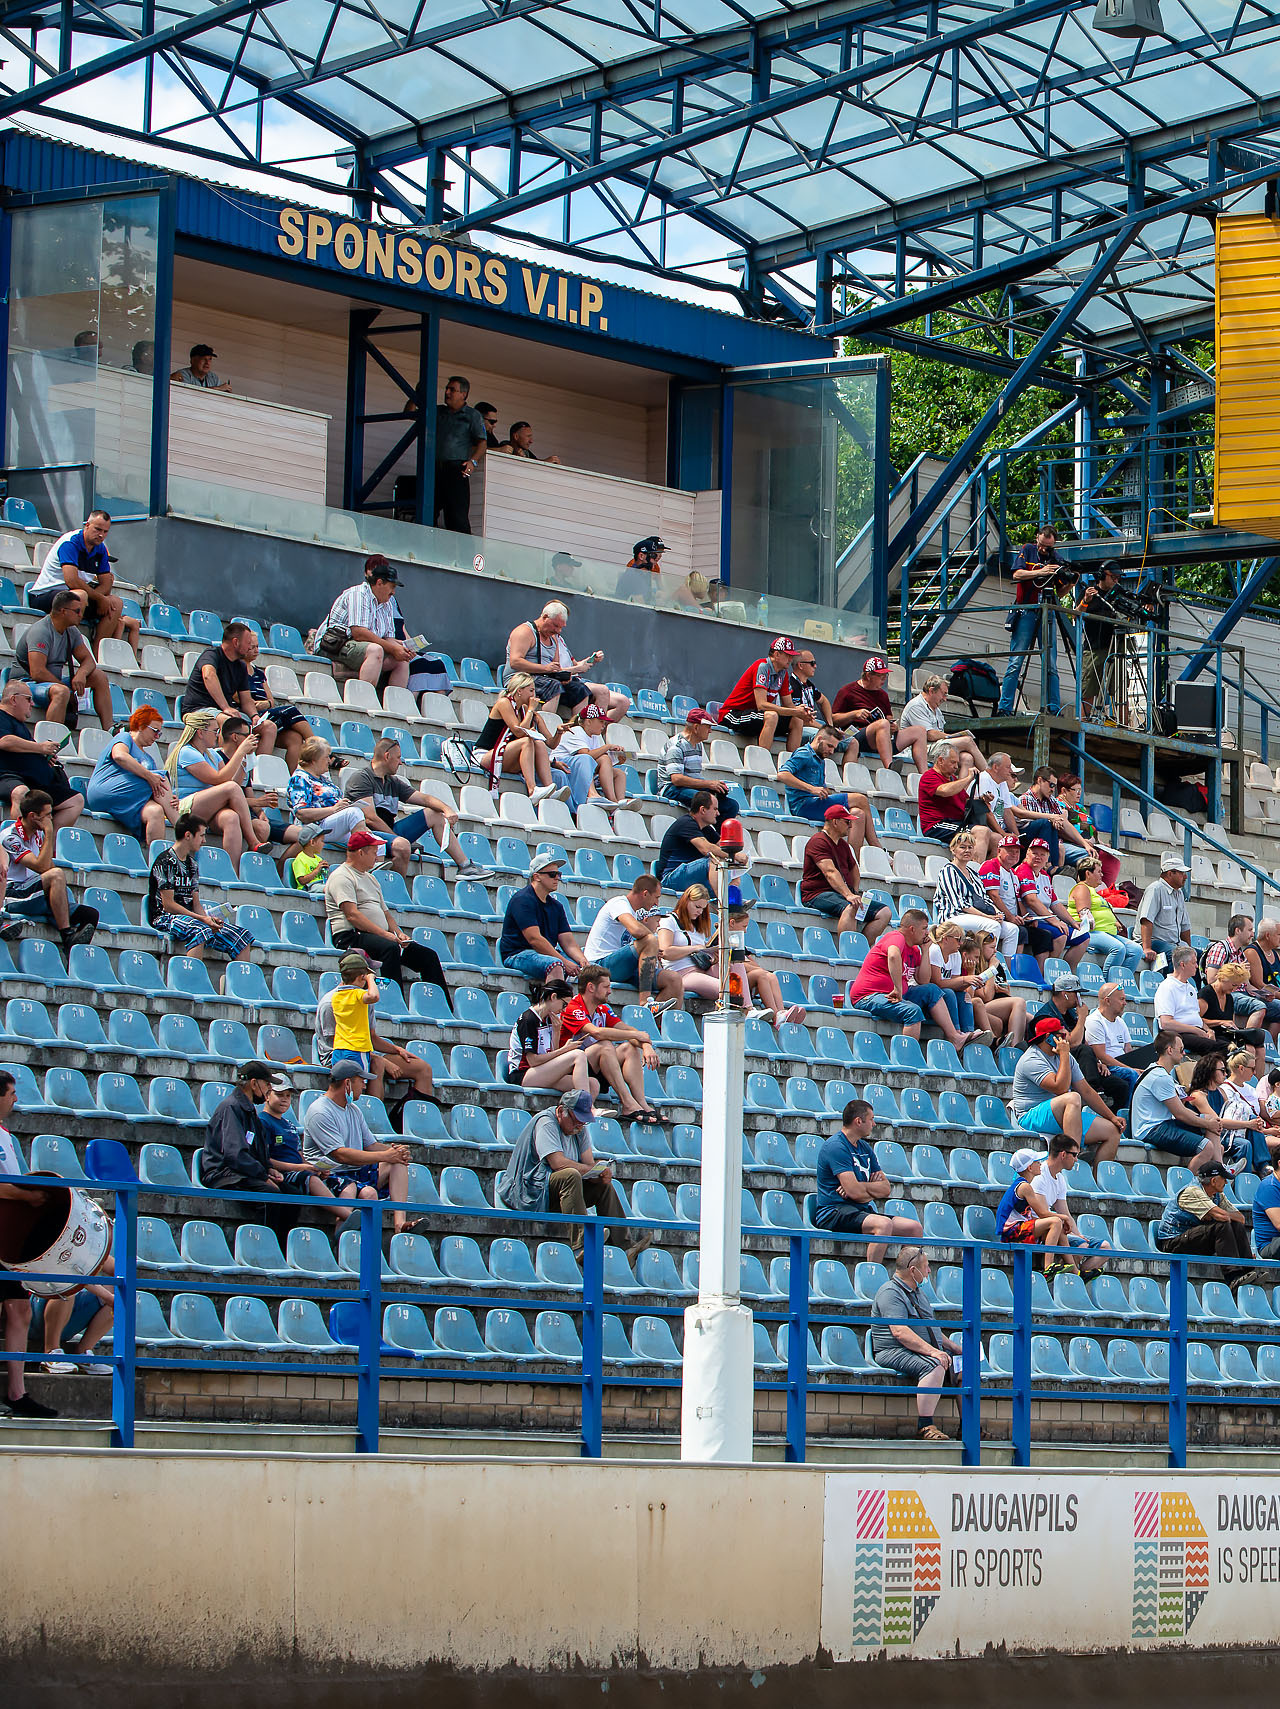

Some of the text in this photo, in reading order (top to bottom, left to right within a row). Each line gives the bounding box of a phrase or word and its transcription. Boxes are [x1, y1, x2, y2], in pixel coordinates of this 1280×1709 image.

[277, 207, 608, 331] SPONSORS V.I.P.
[471, 662, 478, 670] 14
[761, 789, 768, 797] 10
[424, 930, 431, 940] 27
[814, 931, 821, 939] 15
[850, 935, 857, 943] 14
[34, 942, 44, 953] 37
[183, 960, 192, 970] 34
[240, 965, 250, 974] 33
[1087, 965, 1090, 973] 7
[634, 1009, 643, 1018] 24
[678, 1070, 686, 1079] 25
[797, 1081, 806, 1090] 22
[216, 1086, 226, 1096] 37
[986, 1100, 992, 1108] 17
[404, 1236, 414, 1246] 37
[498, 1312, 509, 1323] 37
[952, 1494, 1079, 1533] DAUGAVPILS
[951, 1549, 1043, 1588] IR SPORTS
[1219, 1547, 1233, 1583] IS
